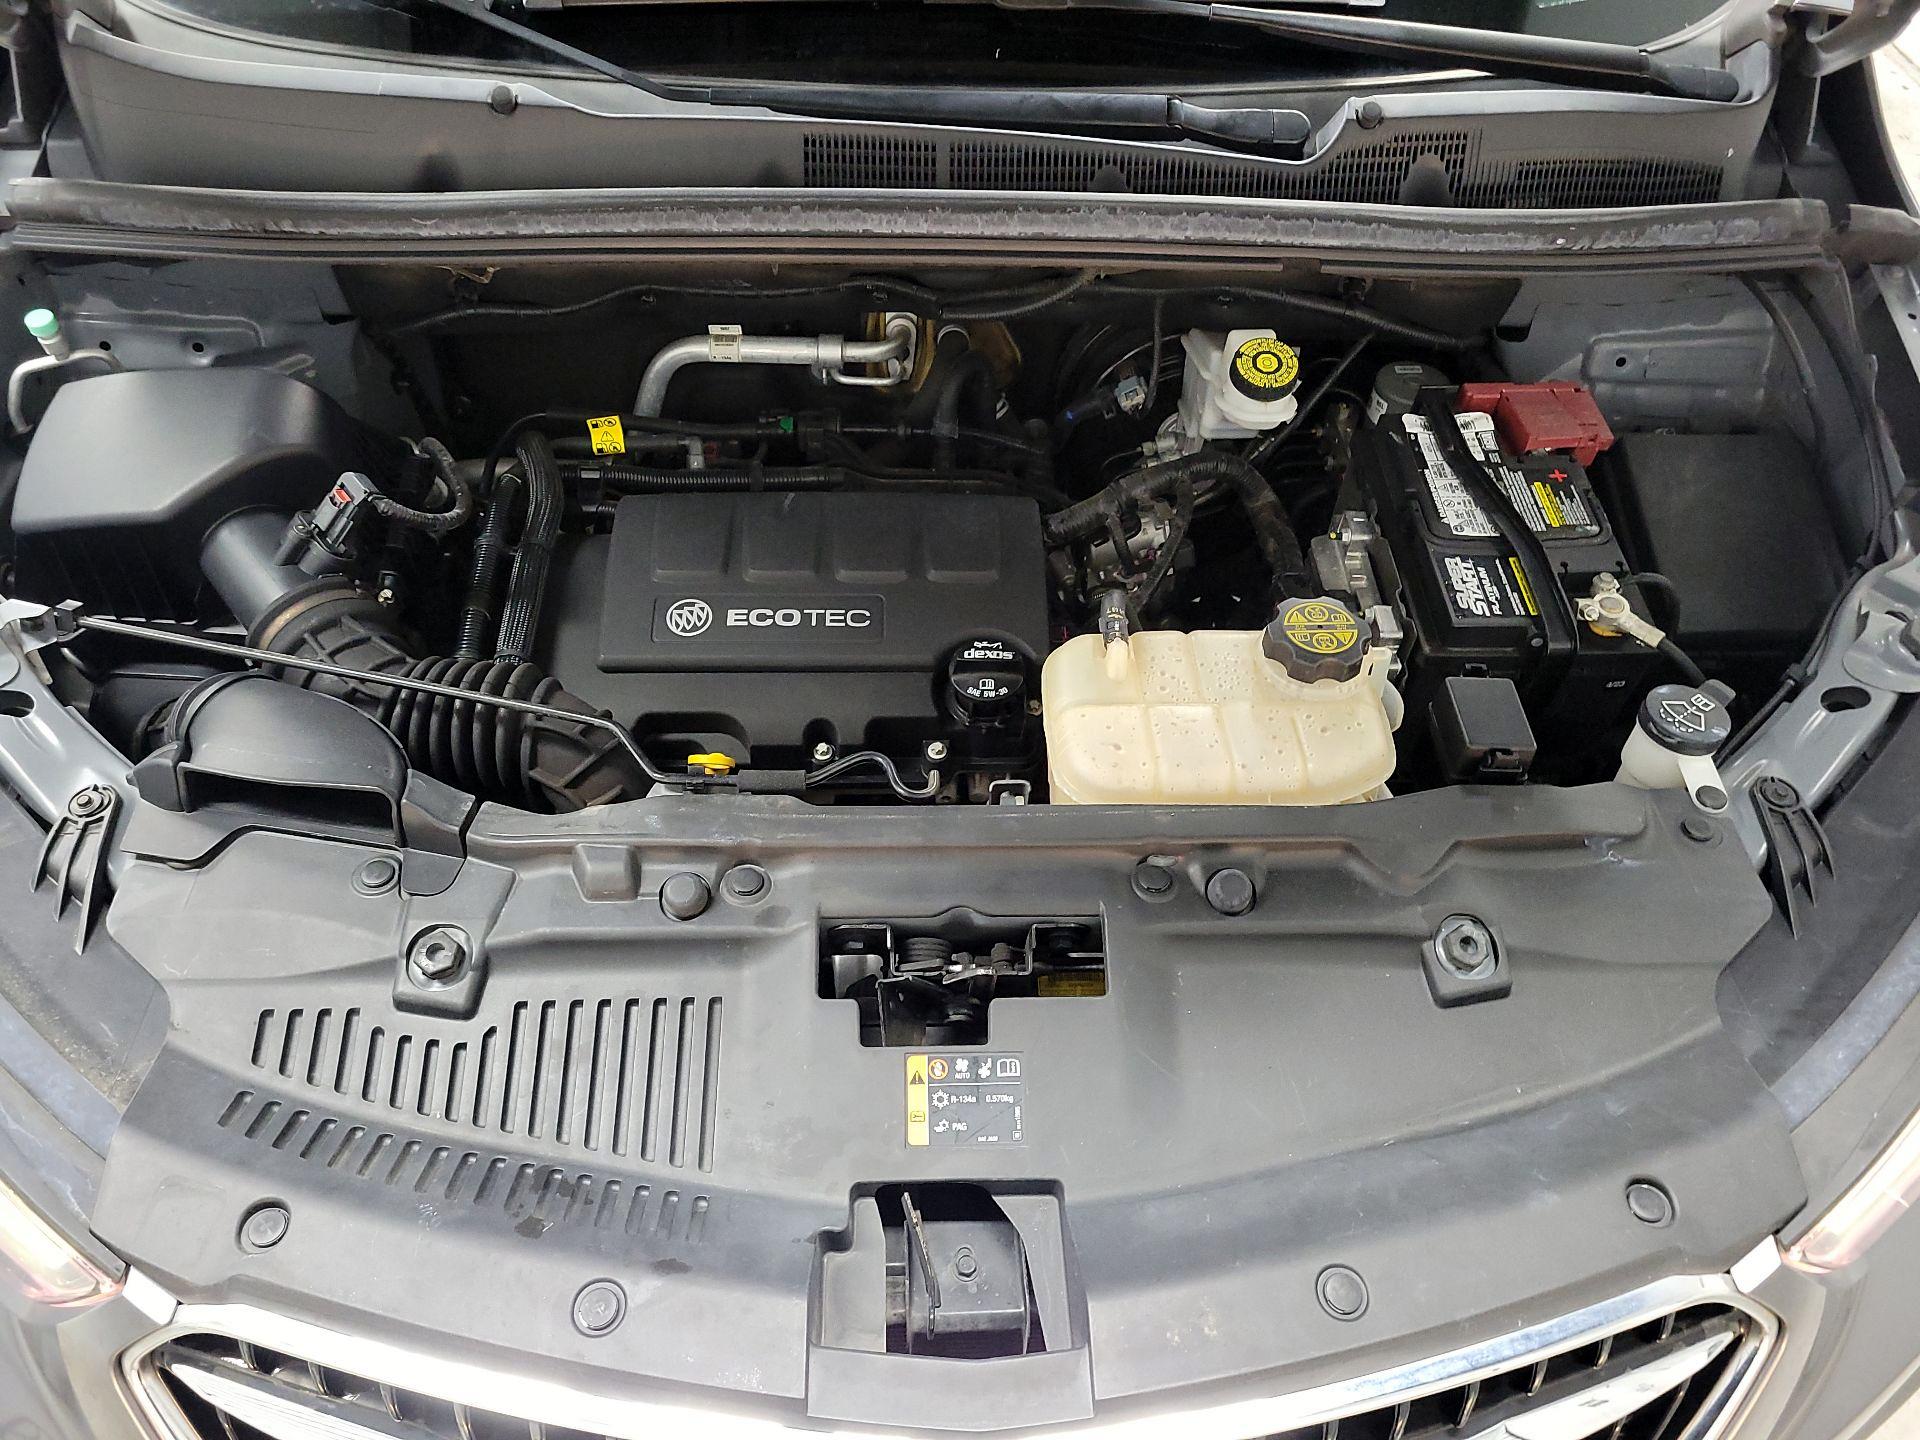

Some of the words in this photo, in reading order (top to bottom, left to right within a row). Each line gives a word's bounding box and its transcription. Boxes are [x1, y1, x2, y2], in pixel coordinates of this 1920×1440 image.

[1444, 557, 1469, 609] SUPER
[1456, 556, 1491, 617] START
[1477, 566, 1503, 615] PLATINUM
[726, 608, 871, 627] ECOTEC
[963, 648, 1014, 660] dexos
[966, 686, 982, 698] SAE
[983, 686, 1009, 698] 5W-30
[954, 1072, 971, 1080] AUTO
[950, 1094, 977, 1104] R-134a
[985, 1094, 1014, 1104] 0.570kg
[951, 1122, 968, 1131] PAG
